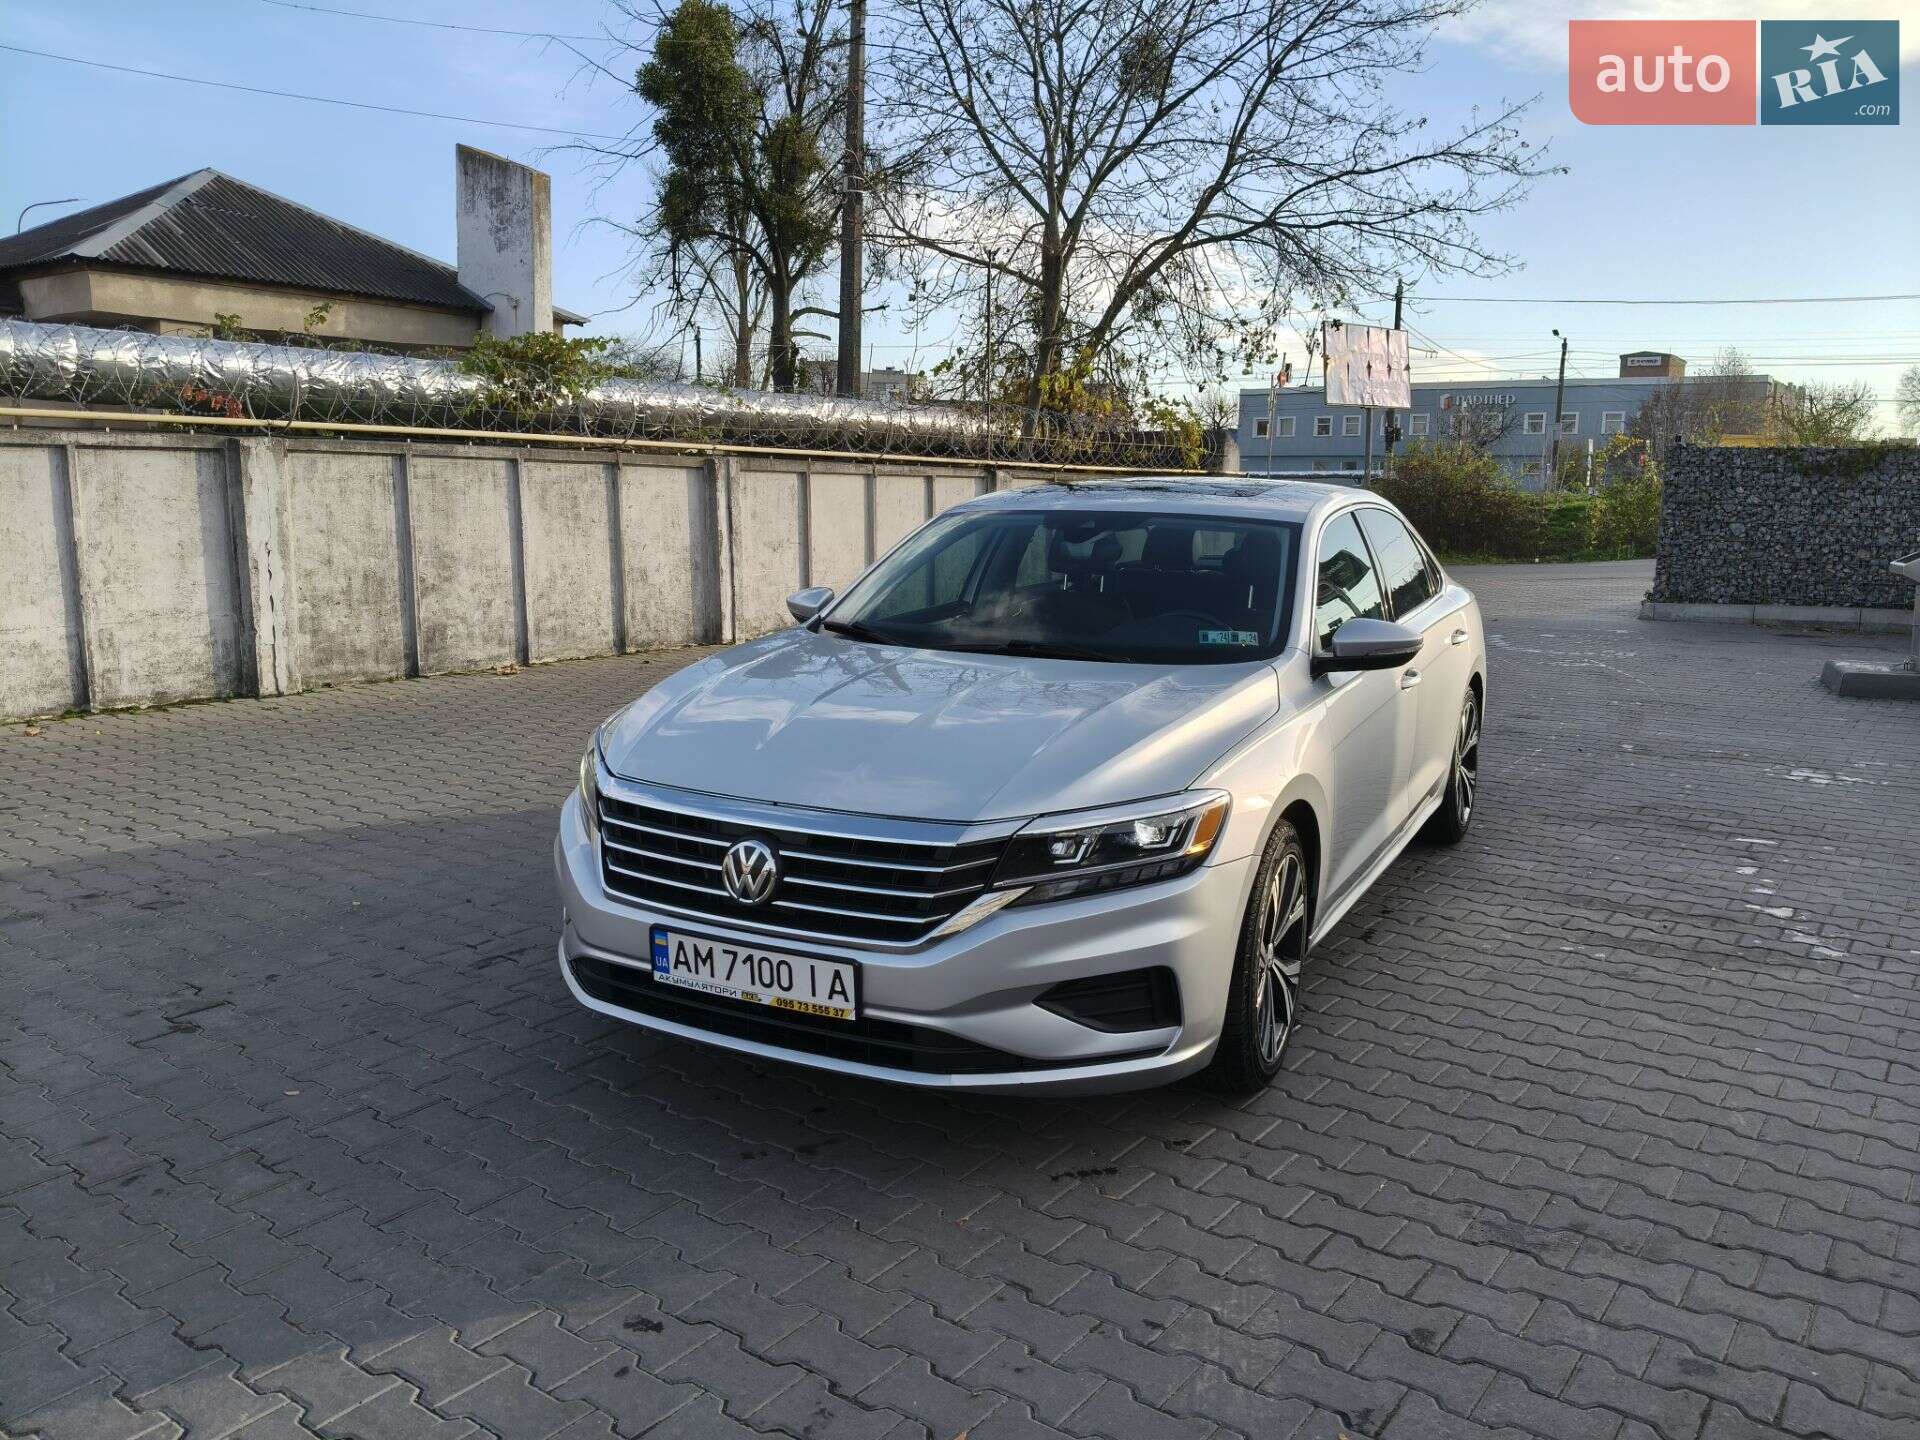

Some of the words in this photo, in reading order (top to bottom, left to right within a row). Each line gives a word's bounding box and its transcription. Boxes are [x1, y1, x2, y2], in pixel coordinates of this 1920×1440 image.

[656, 956, 669, 967] UA
[673, 940, 715, 978] AM
[722, 949, 793, 992] 7100
[659, 974, 737, 997] АКУМУЛЯТОРИ
[798, 1002, 809, 1012] 73
[833, 1008, 846, 1018] 37
